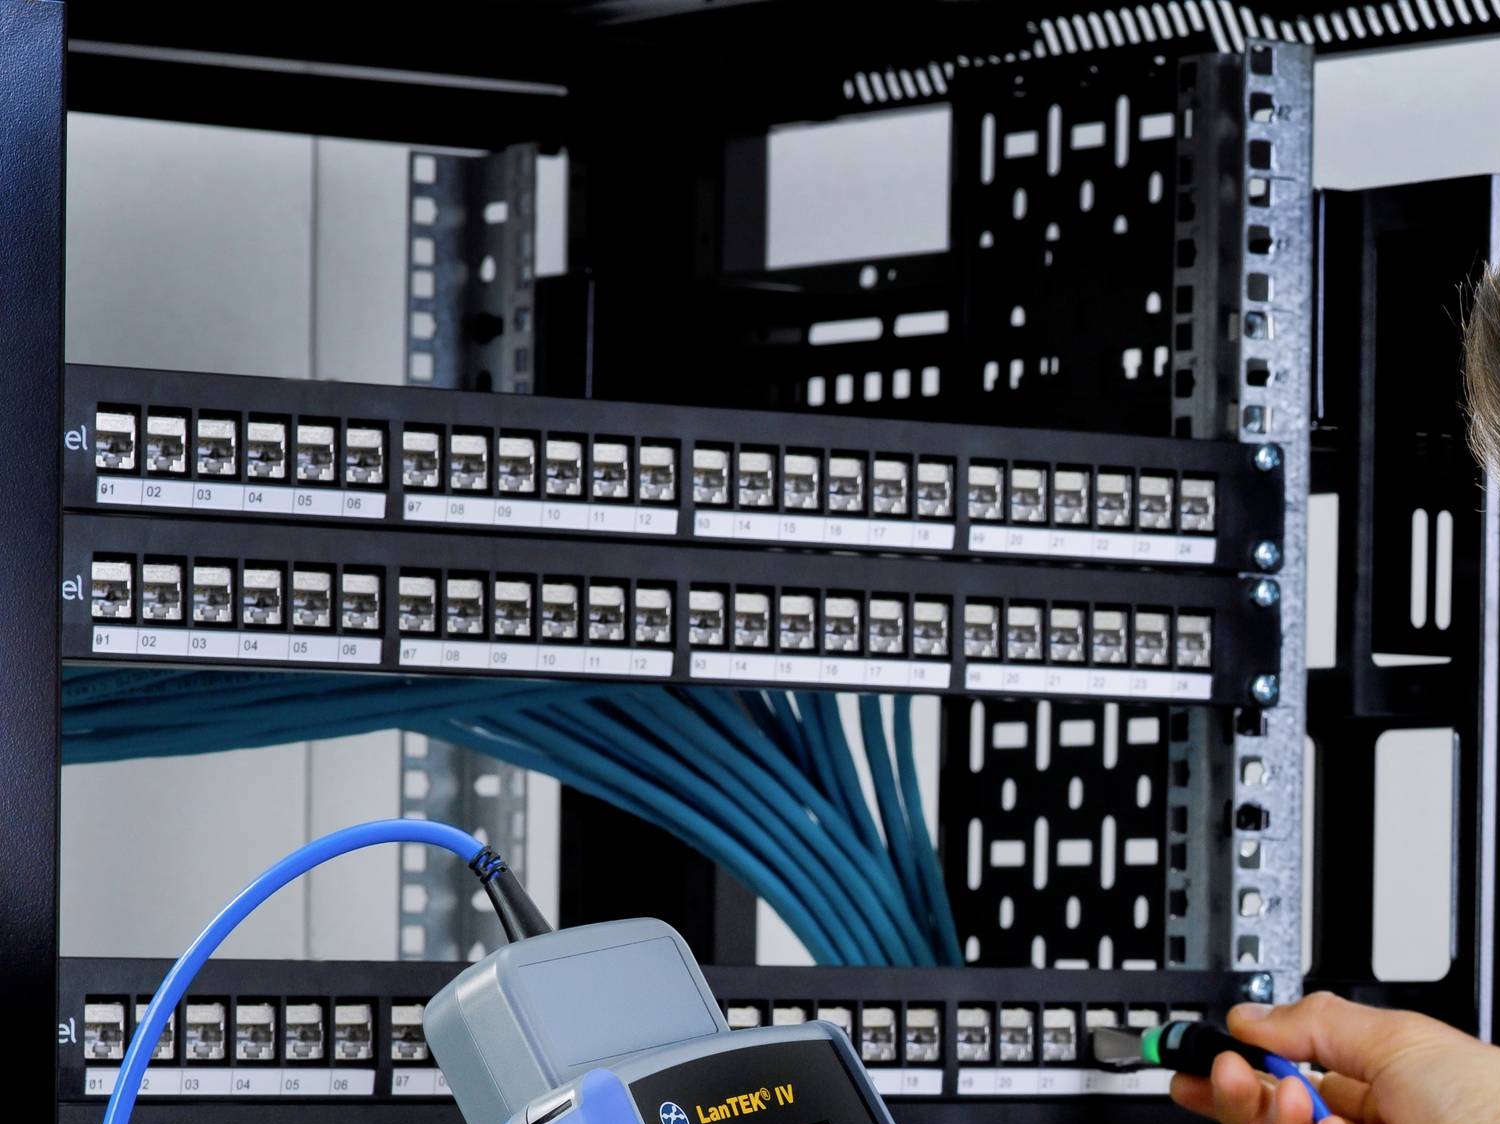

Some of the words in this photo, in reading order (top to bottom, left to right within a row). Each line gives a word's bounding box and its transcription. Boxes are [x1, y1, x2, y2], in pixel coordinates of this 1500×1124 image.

[147, 487, 161, 498] 02
[197, 489, 211, 500] 03
[248, 492, 262, 504] 04
[298, 495, 312, 506] 05
[347, 498, 361, 509] 06
[142, 636, 156, 647] 02
[192, 638, 206, 649] 03
[244, 640, 258, 650] 04
[294, 642, 307, 653] 05
[343, 644, 357, 655] 06
[185, 1078, 199, 1090] 03
[236, 1079, 250, 1090] 04
[285, 1079, 300, 1090] 05
[334, 1079, 348, 1090] 06
[696, 1088, 770, 1124] LanTEK®
[774, 1084, 794, 1106] IV
